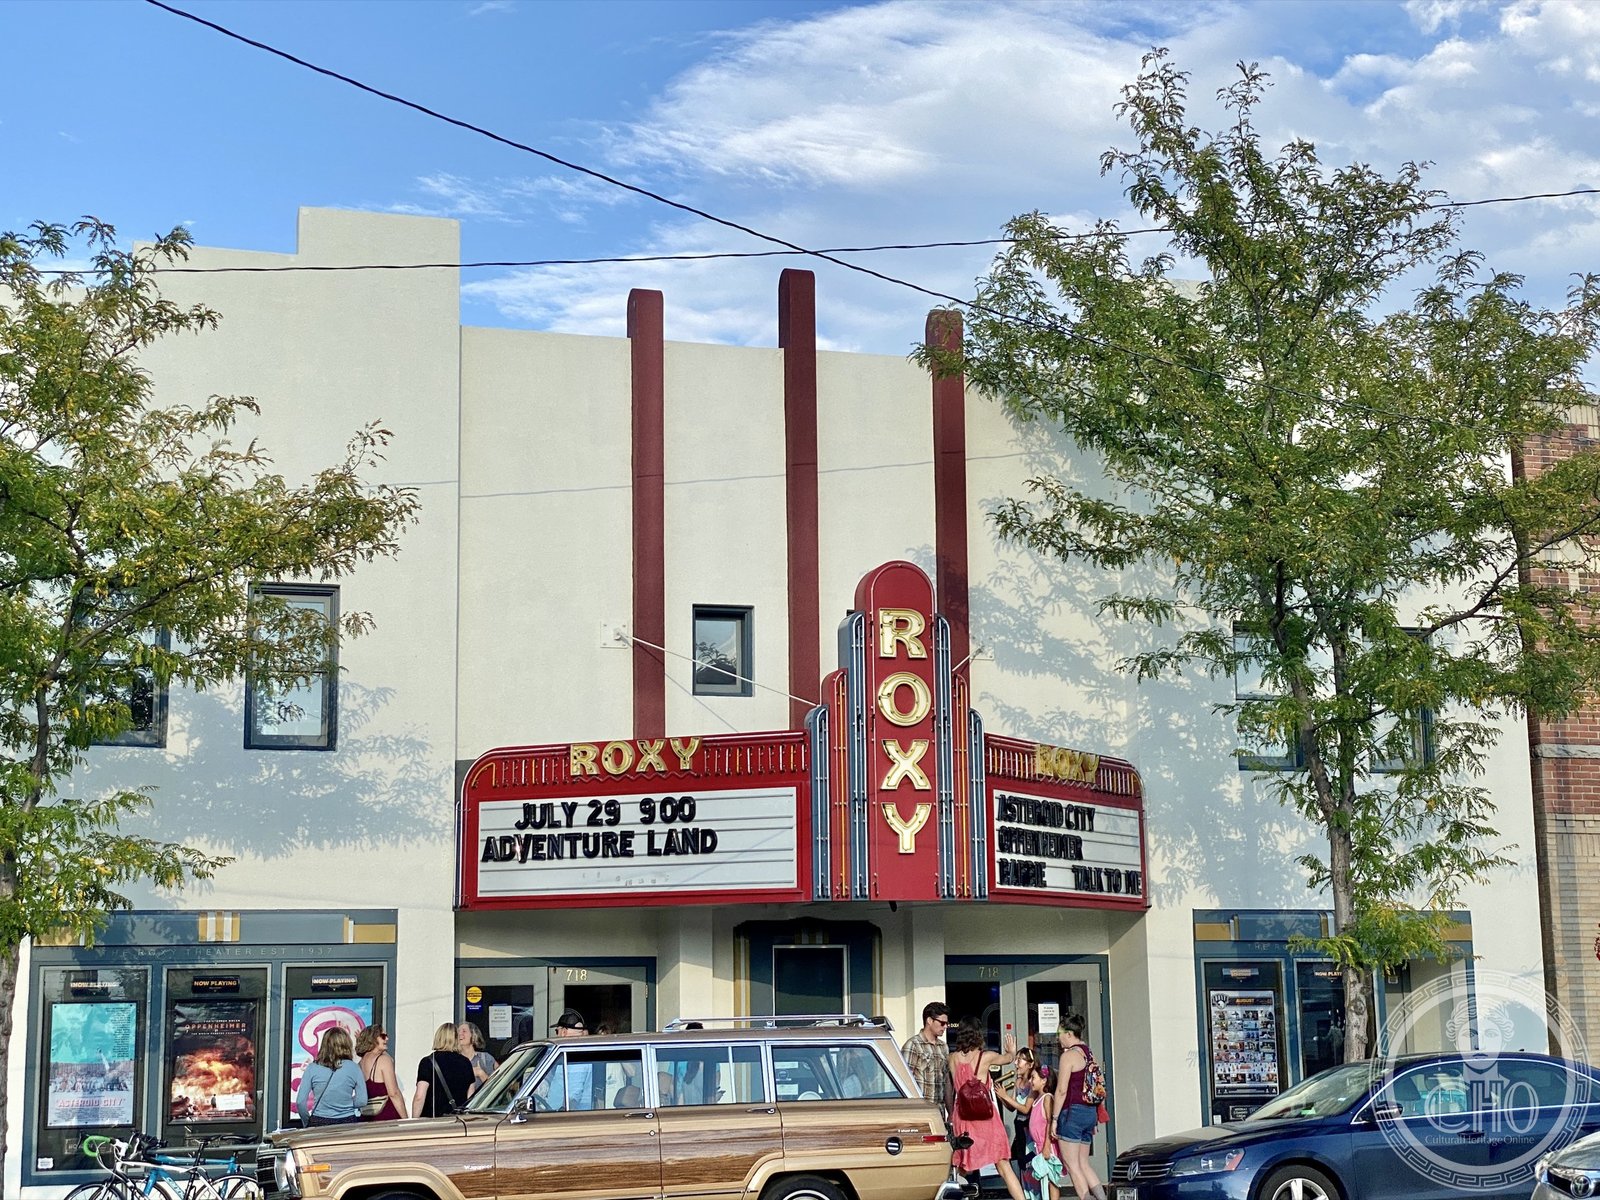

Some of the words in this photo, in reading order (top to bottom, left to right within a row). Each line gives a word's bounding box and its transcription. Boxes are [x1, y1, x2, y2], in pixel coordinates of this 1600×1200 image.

[877, 608, 932, 854] ROXY
[569, 737, 701, 777] ROXY
[1035, 744, 1100, 783] ROXY
[514, 802, 579, 830] JULY
[586, 799, 621, 827] 29
[997, 794, 1064, 829] ASTEROID
[1064, 803, 1096, 832] CITY
[480, 831, 635, 863] ADVENTURE
[646, 827, 718, 856] LAND
[1071, 864, 1104, 893] TALK
[1104, 867, 1122, 893] TO
[186, 947, 251, 957] THEATER
[260, 947, 287, 956] EST
[300, 946, 333, 956] 1937
[194, 979, 210, 987] NOW
[210, 979, 238, 987] PLAYING
[329, 976, 356, 985] PLAYING
[566, 969, 588, 981] 718
[979, 966, 999, 978] 718
[184, 1022, 247, 1030] OPPENHEIMER
